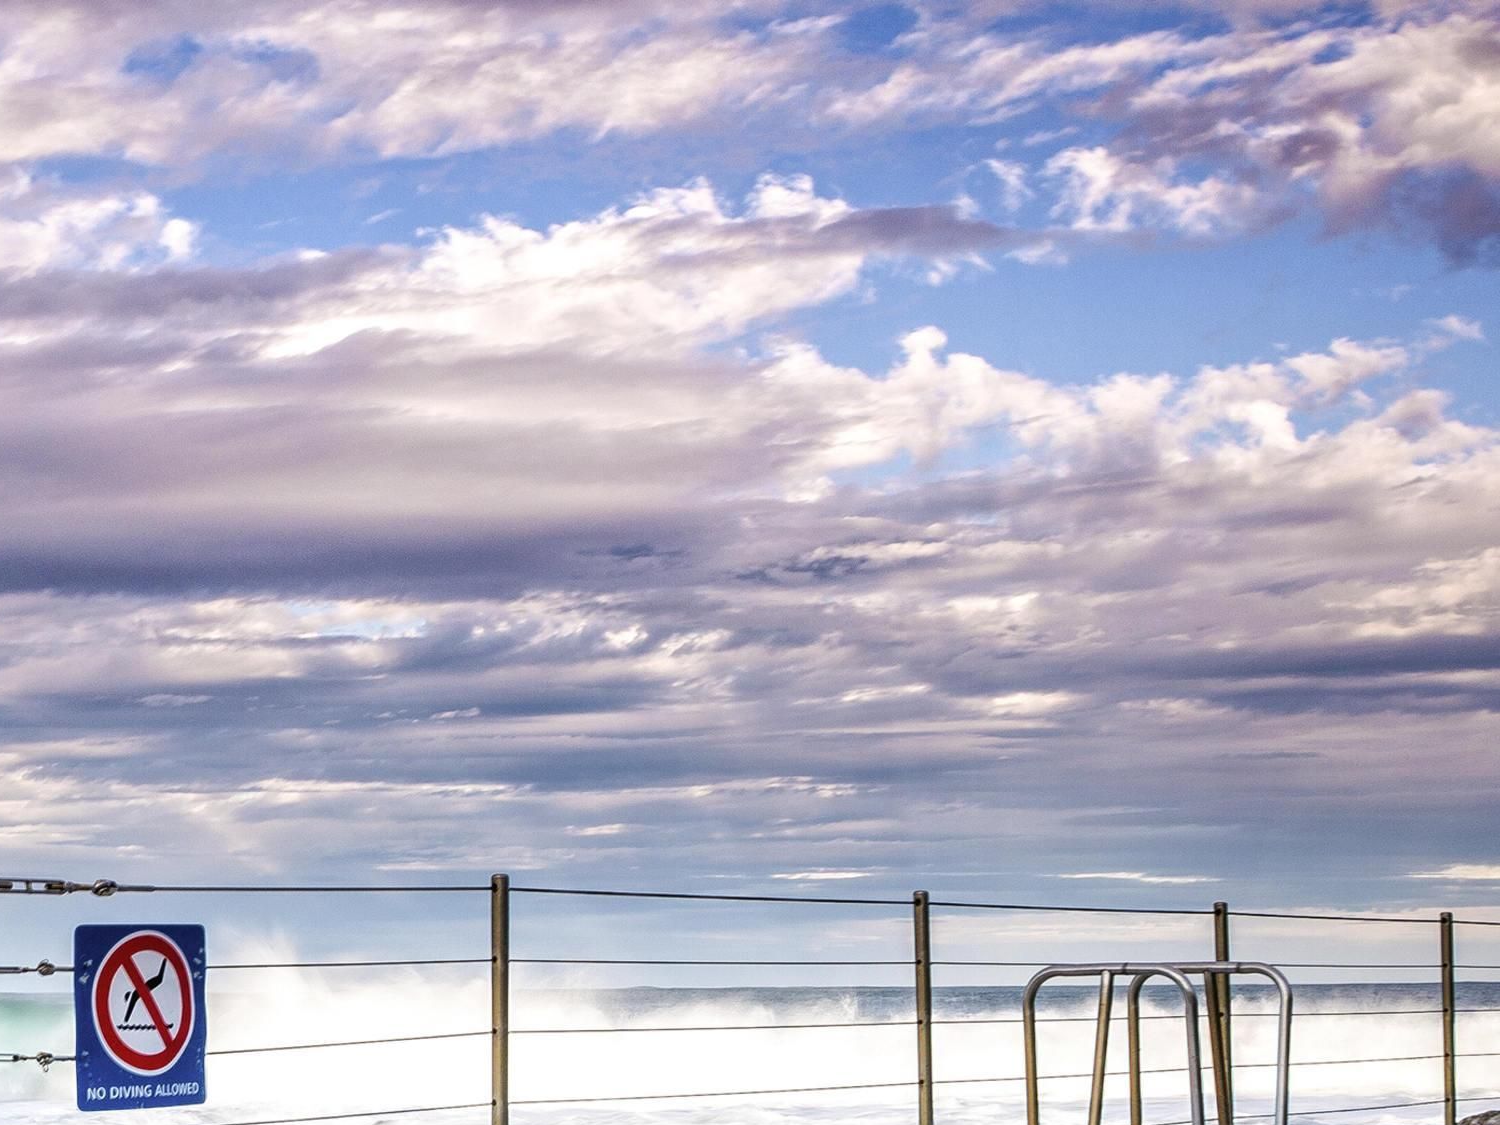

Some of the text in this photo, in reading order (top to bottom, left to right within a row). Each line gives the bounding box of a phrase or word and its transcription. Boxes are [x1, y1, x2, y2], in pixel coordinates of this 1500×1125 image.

[87, 1082, 199, 1101] NO DIVING ALLOWED
